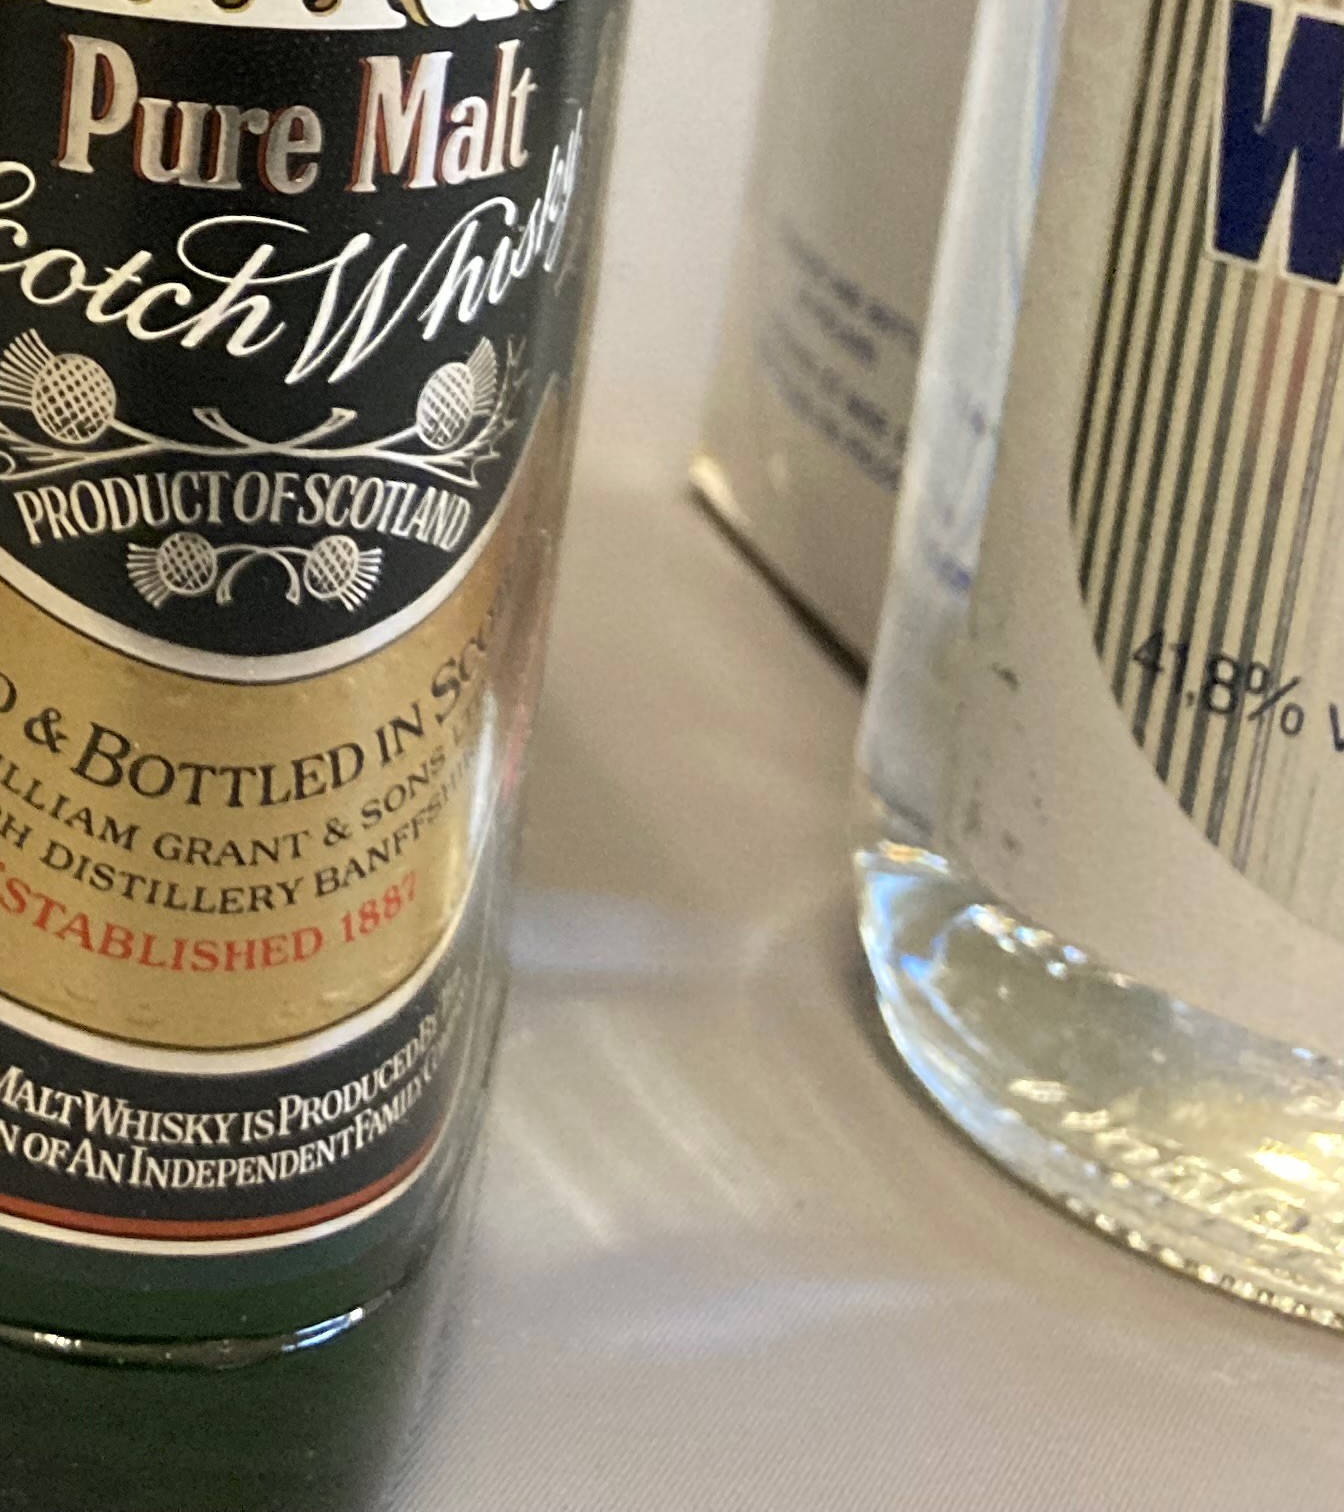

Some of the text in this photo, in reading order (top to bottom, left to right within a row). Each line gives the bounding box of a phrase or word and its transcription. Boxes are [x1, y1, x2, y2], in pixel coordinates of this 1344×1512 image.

[52, 33, 538, 195] Pure Malt
[178, 107, 584, 386] Whisky
[13, 471, 474, 553] PRODUCT OF SCOTLAND
[24, 705, 70, 757] &
[71, 721, 365, 811] BOTTLED
[375, 700, 425, 769] IN
[152, 832, 312, 868] GRANT
[322, 817, 352, 850] &
[361, 743, 447, 831] SONS
[39, 840, 306, 917] DISTILLERY
[338, 870, 421, 945] 1887
[80, 1089, 240, 1145] WHISKY
[242, 1109, 277, 1142] IS
[278, 1031, 424, 1137] PRODUCED
[22, 1131, 72, 1169] OF
[67, 1137, 127, 1184] AN
[127, 1126, 355, 1189] INDEPENDENT
